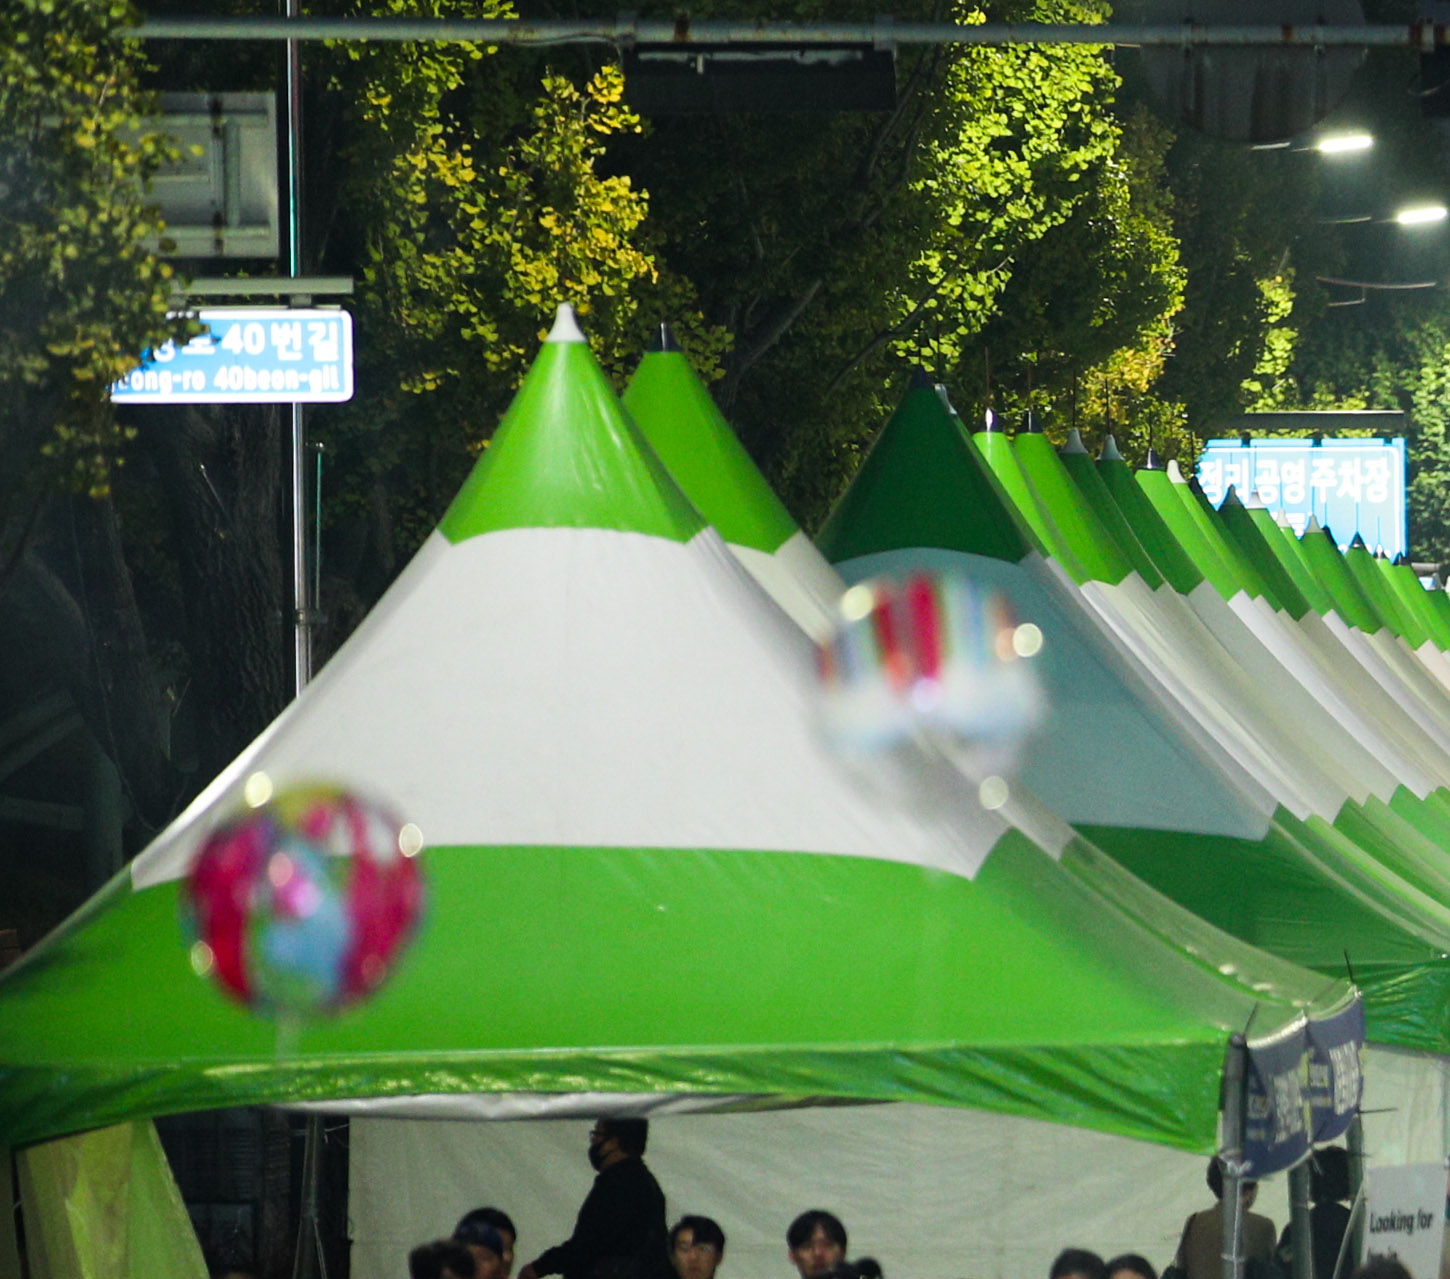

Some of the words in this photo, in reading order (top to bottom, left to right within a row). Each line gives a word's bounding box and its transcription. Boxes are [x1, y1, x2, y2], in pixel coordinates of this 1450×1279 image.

[213, 364, 339, 395] 40beon-gil
[1370, 1209, 1414, 1236] Looking
[1417, 1207, 1433, 1230] for
